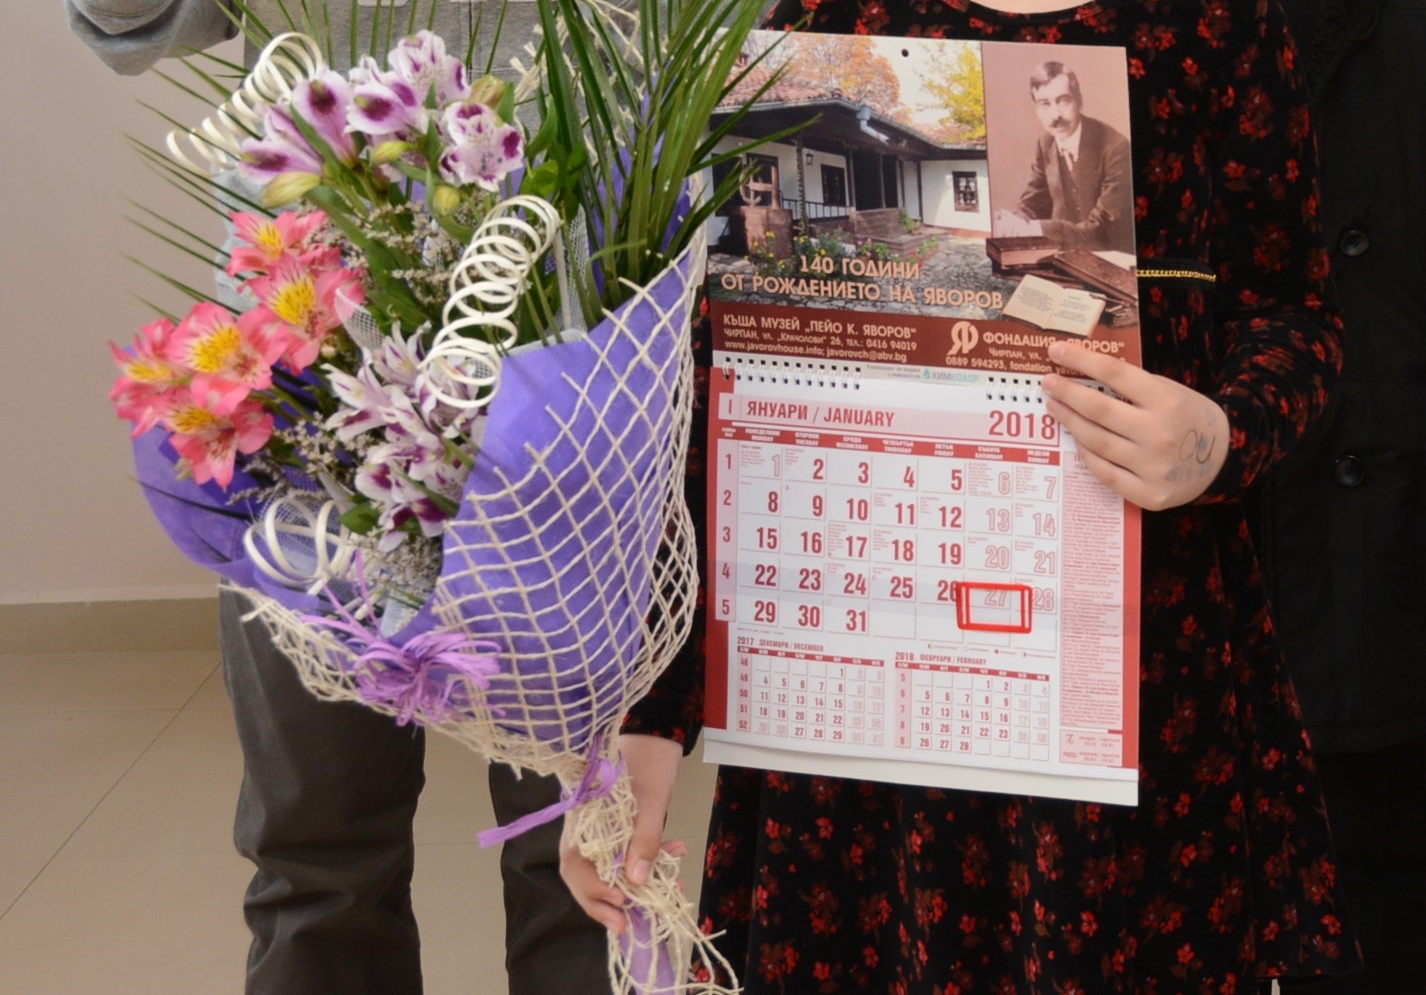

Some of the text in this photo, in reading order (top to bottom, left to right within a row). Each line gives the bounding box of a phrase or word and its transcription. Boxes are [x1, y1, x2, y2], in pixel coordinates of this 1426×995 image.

[800, 255, 920, 280] 140 ГОДИНИ
[721, 274, 1003, 309] ОТ РОЖДЕНИЕТО НА ЯВОРОВ
[761, 316, 800, 331] МУЗЕЙ
[847, 323, 859, 336] К.
[983, 331, 1056, 348] ФОНДАЦИЯ
[866, 338, 888, 349] 0416
[890, 341, 917, 352] 94019
[945, 356, 968, 367] 0889
[747, 401, 808, 420] ЯНУАРИ
[823, 407, 895, 427] JANUARY
[988, 410, 1056, 440] 2018
[771, 454, 780, 478] 1
[812, 458, 824, 480] 2
[858, 462, 869, 484] 3
[903, 466, 915, 488] 4
[951, 469, 963, 492] 5
[998, 471, 1010, 495] 6
[1044, 476, 1057, 499] 7
[768, 491, 1056, 537] 8 9 10 11 12 13 14
[756, 527, 778, 550] 15
[800, 531, 822, 554] 16
[845, 535, 868, 558] 17
[892, 539, 914, 562] 18
[939, 542, 962, 566] 19
[985, 545, 1010, 570] 20
[1034, 550, 1056, 575] 21
[754, 564, 777, 587] 22
[798, 568, 822, 591] 23
[843, 572, 867, 595] 24
[890, 576, 914, 599] 25
[754, 600, 867, 632] 29 30 31
[737, 636, 754, 646] 2017
[895, 652, 914, 661] 2018
